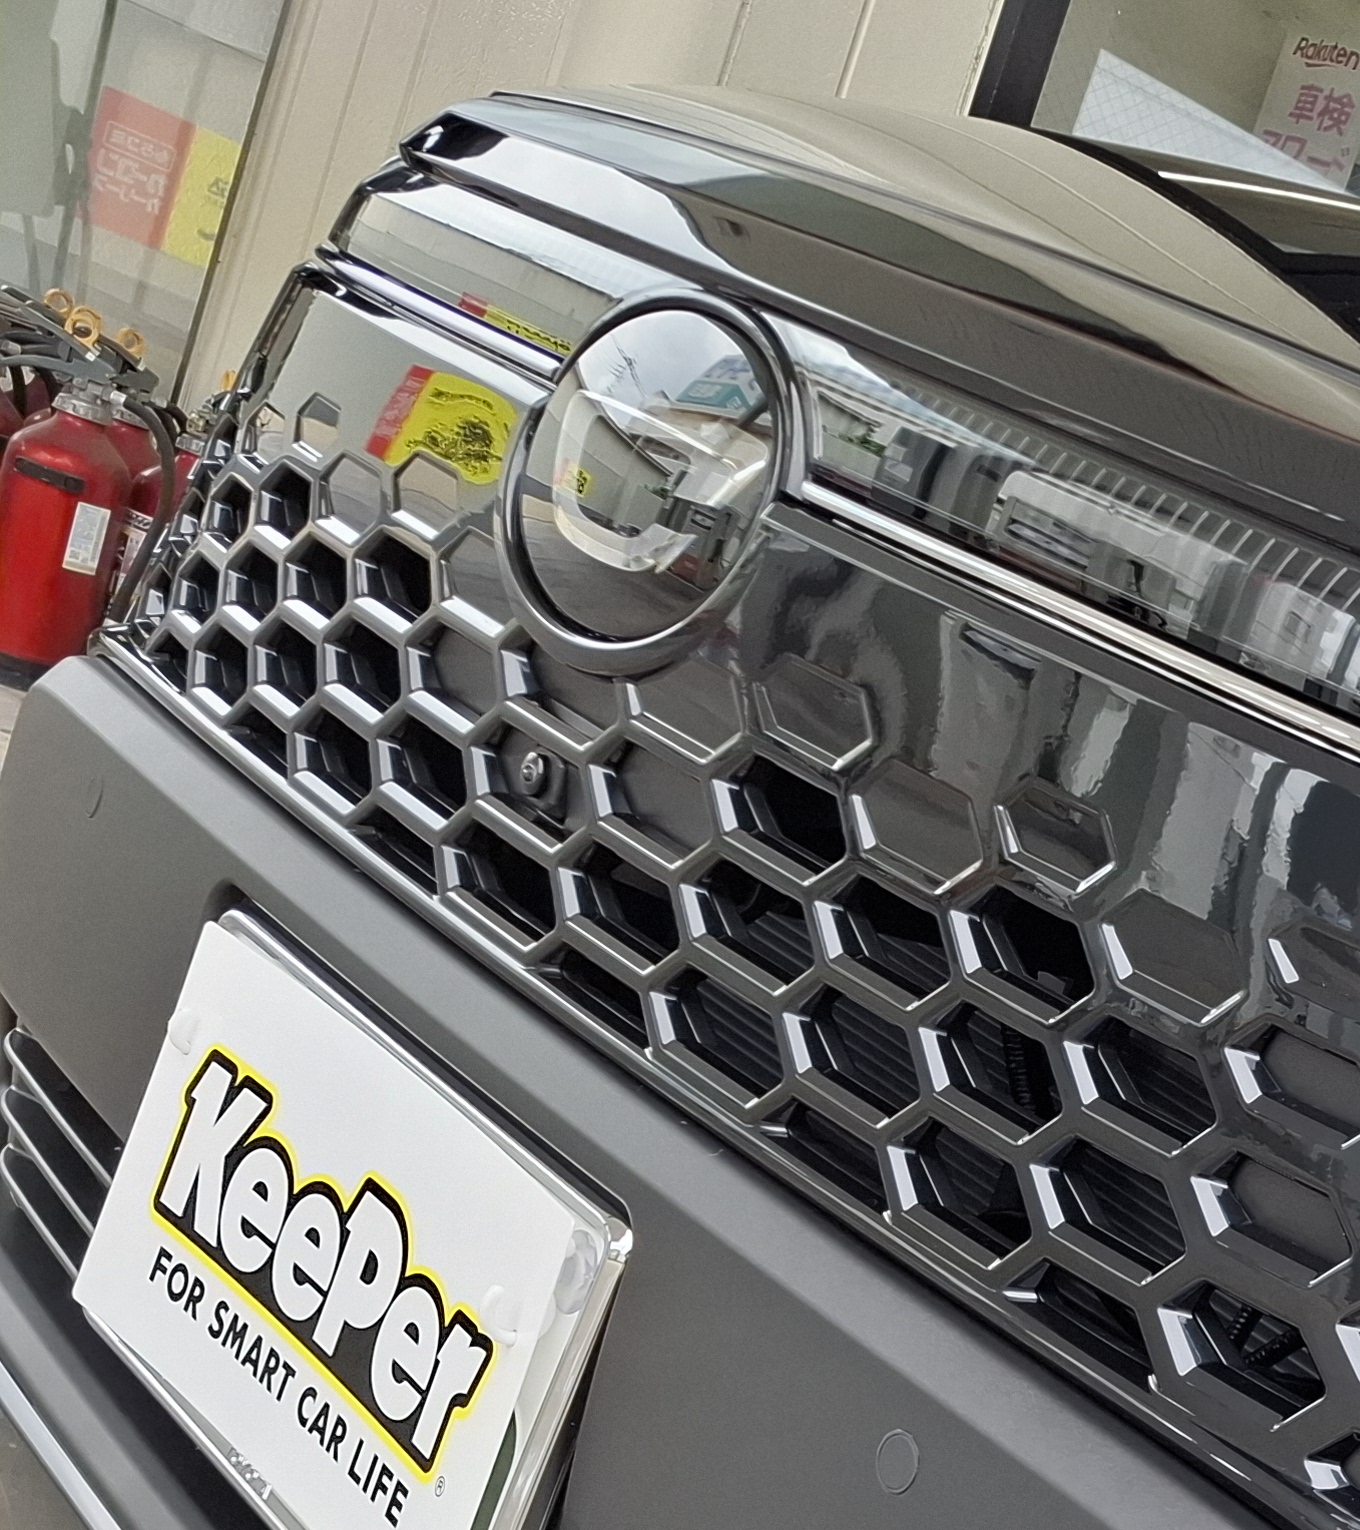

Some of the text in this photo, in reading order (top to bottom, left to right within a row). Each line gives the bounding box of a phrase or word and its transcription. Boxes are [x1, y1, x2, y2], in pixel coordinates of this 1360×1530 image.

[1288, 84, 1357, 137] 車検
[1293, 36, 1360, 70] Rakuten
[154, 1048, 493, 1474] KeePer
[149, 1246, 205, 1321] FOR
[208, 1300, 297, 1402] SMART
[297, 1386, 348, 1463] CAR
[347, 1438, 410, 1529] LIFE
